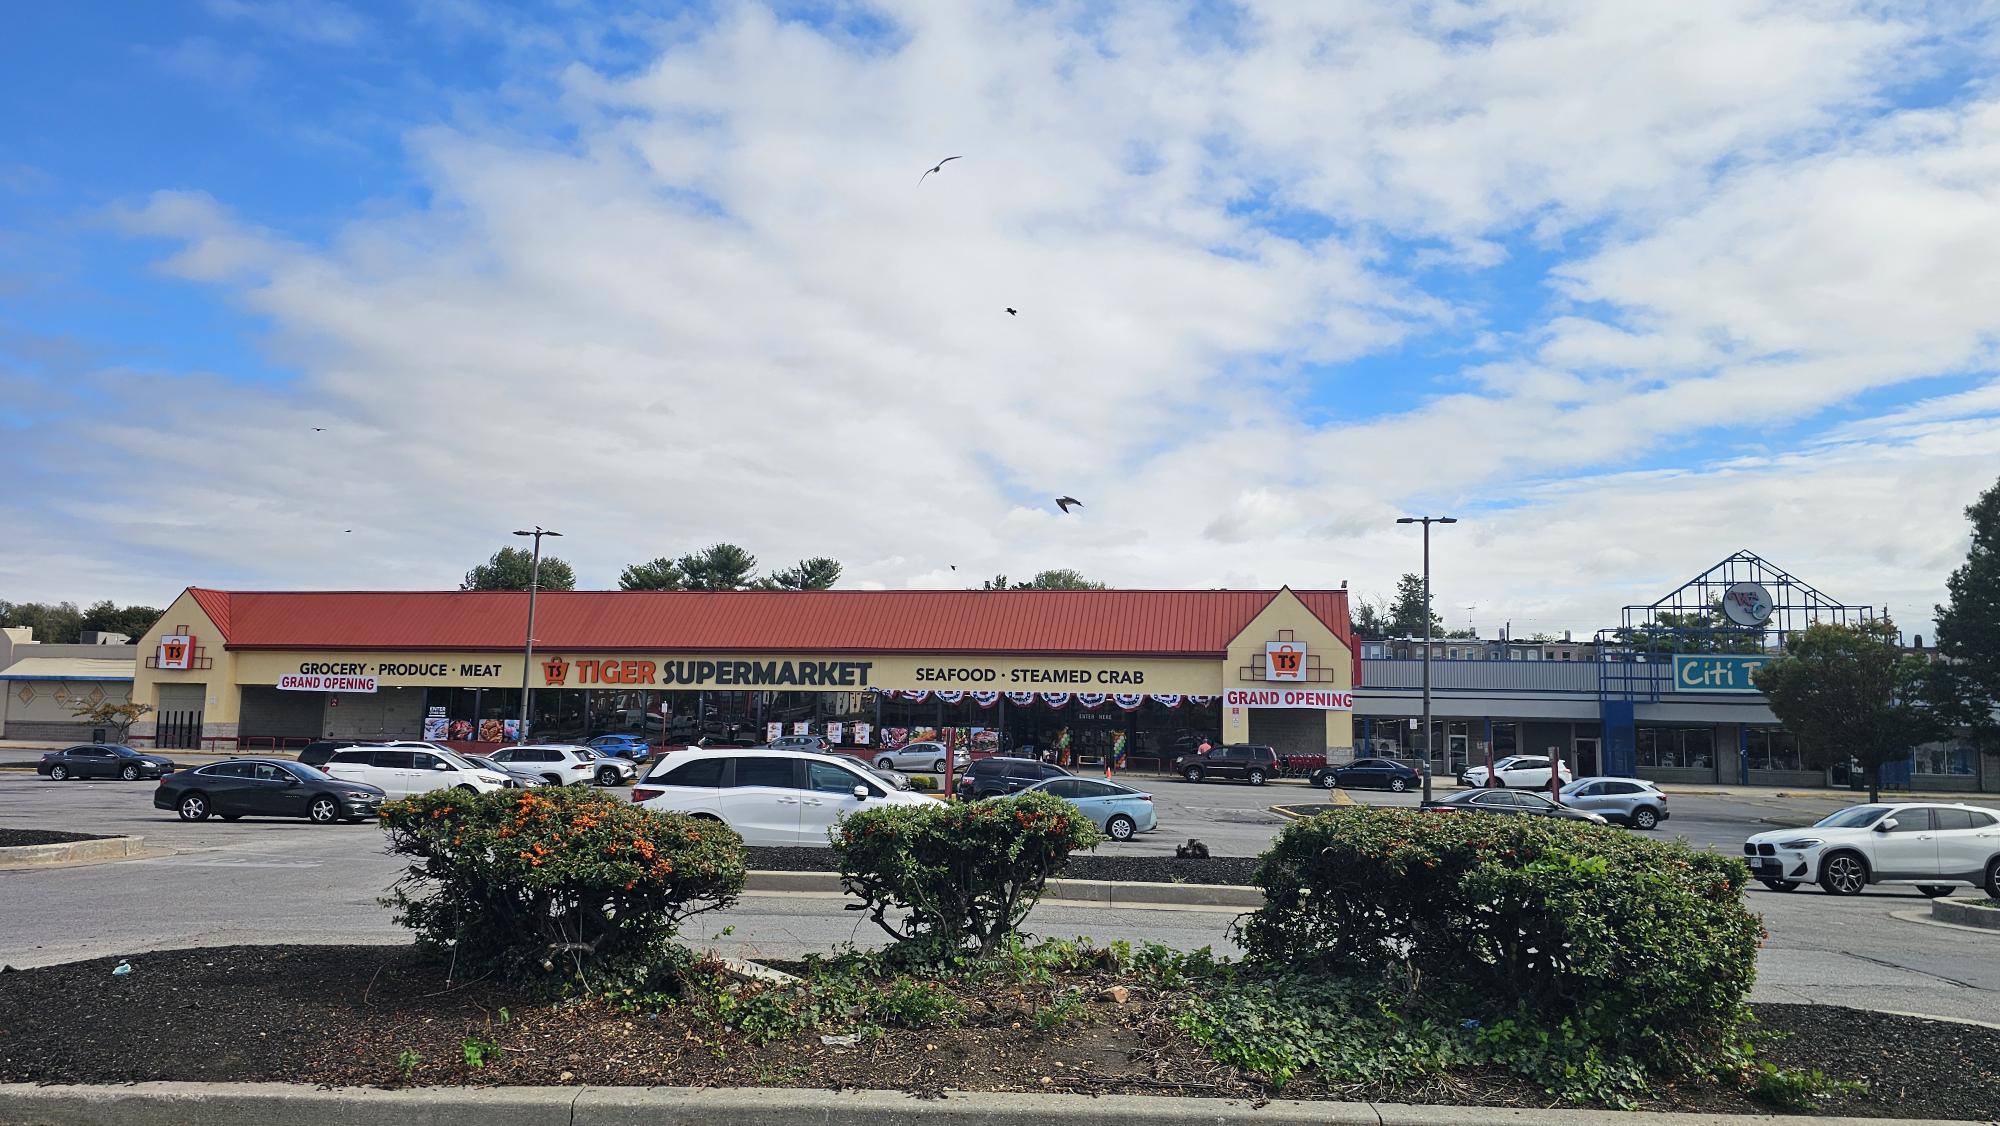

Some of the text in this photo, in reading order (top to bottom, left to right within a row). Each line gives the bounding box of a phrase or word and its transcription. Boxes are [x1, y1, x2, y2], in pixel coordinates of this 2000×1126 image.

[169, 646, 182, 659] TS
[299, 662, 502, 677] GROCERY PRODUCE MEAT
[1278, 655, 1296, 669] TS
[548, 665, 562, 677] TS
[576, 660, 872, 685] TIGER SUPERMARKET
[916, 668, 1144, 685] SEAFOOD STEAMED CRAB
[1682, 661, 1733, 685] Citi
[282, 676, 374, 690] GRAND OPENING
[1228, 690, 1353, 707] GRAND OPENING
